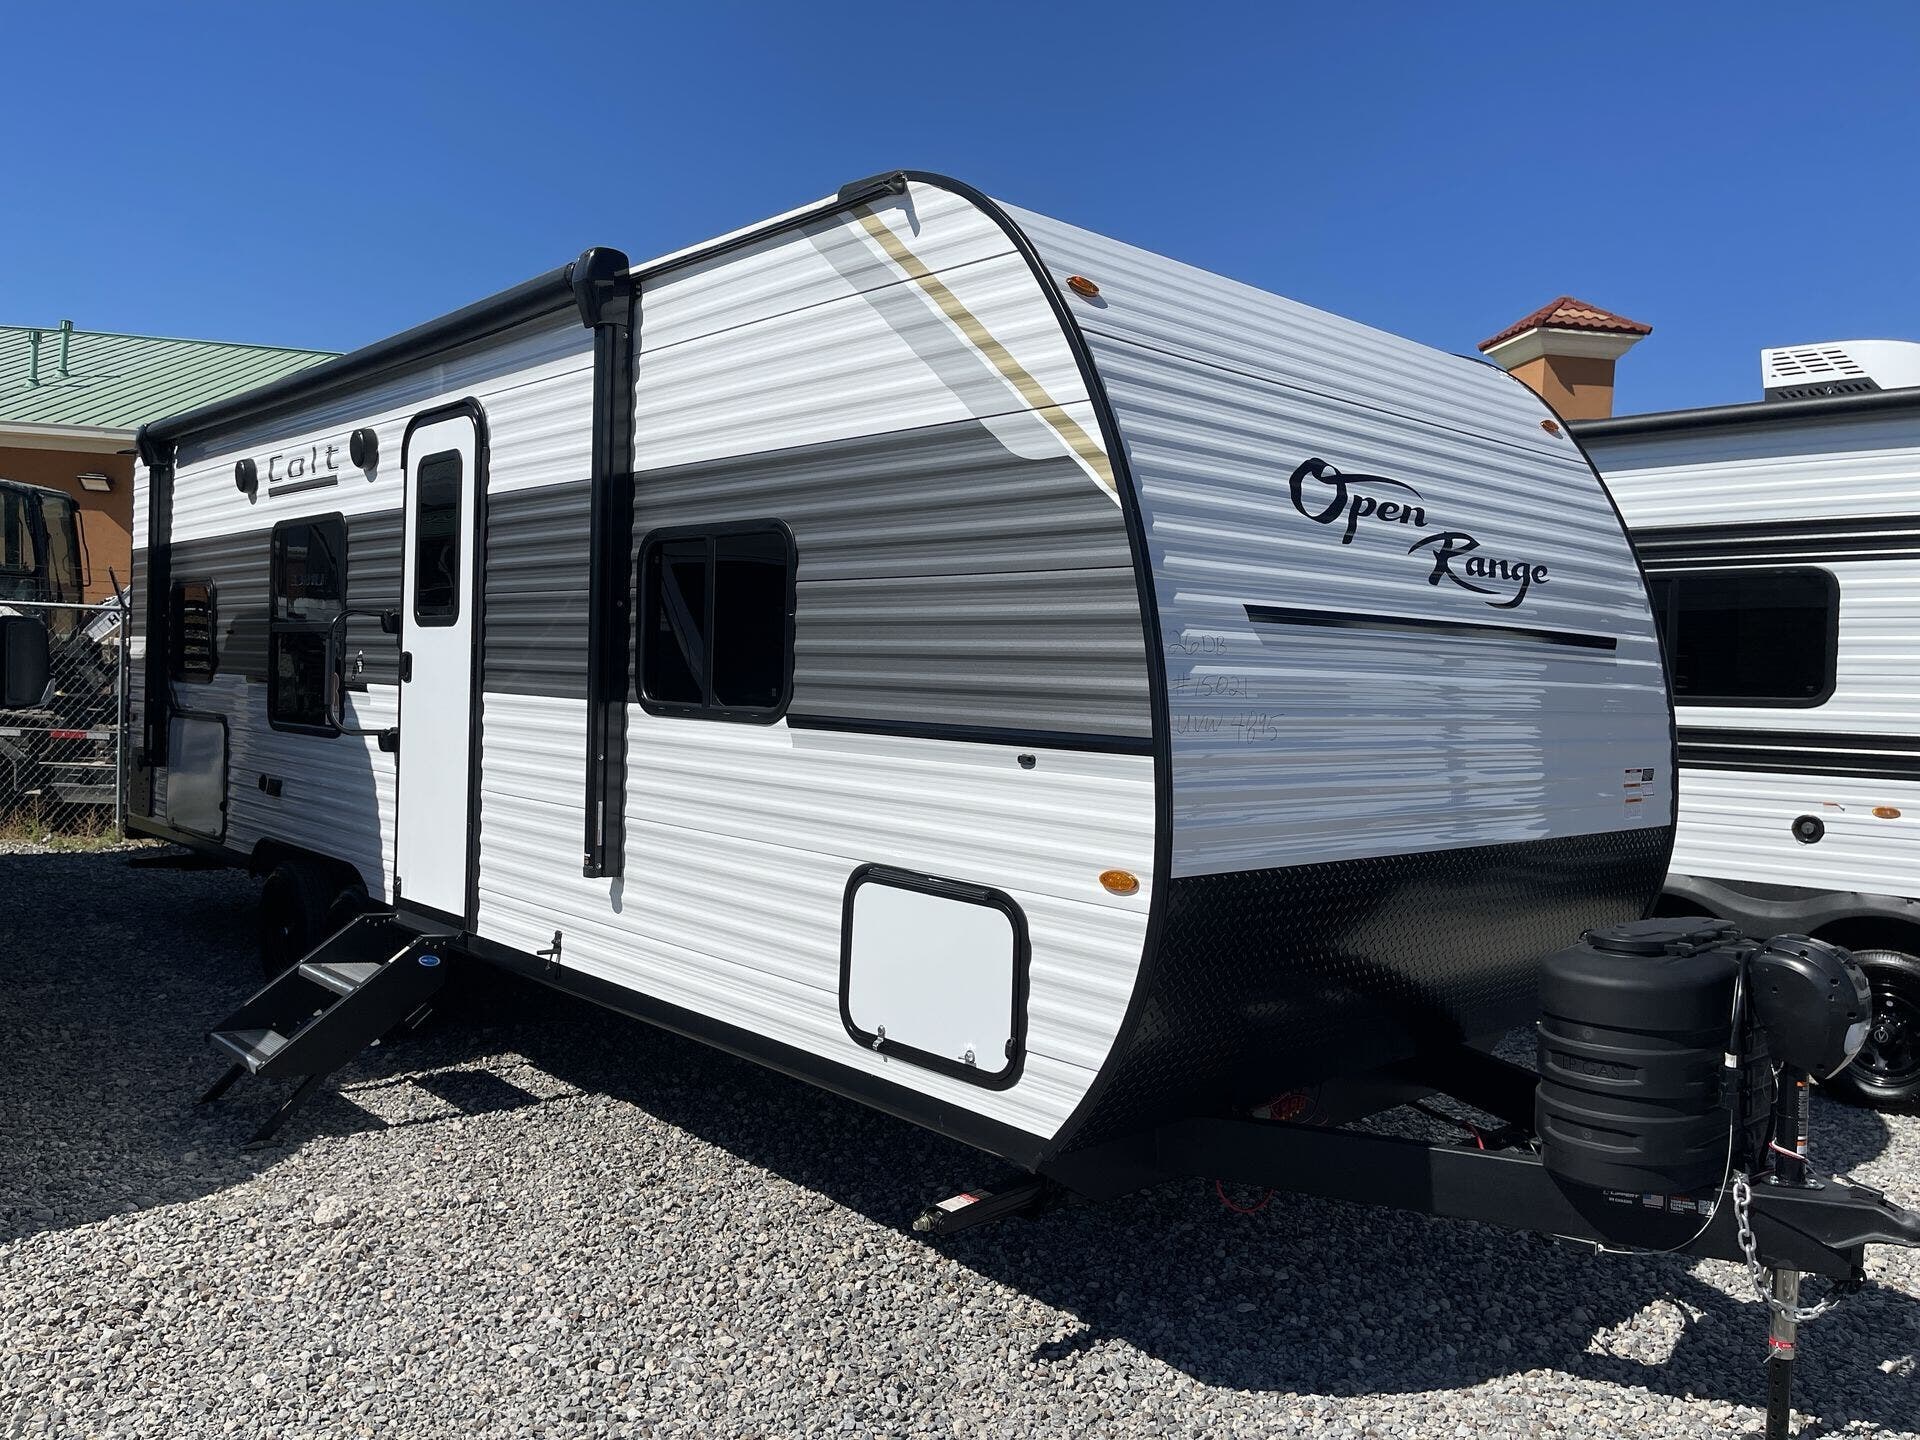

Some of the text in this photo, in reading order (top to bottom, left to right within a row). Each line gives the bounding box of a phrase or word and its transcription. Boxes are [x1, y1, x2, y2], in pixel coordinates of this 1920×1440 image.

[268, 445, 340, 482] Colt
[1289, 457, 1428, 544] Open
[1407, 531, 1550, 609] Range
[1167, 630, 1228, 656] 26DB
[1582, 1060, 1622, 1081] GAS
